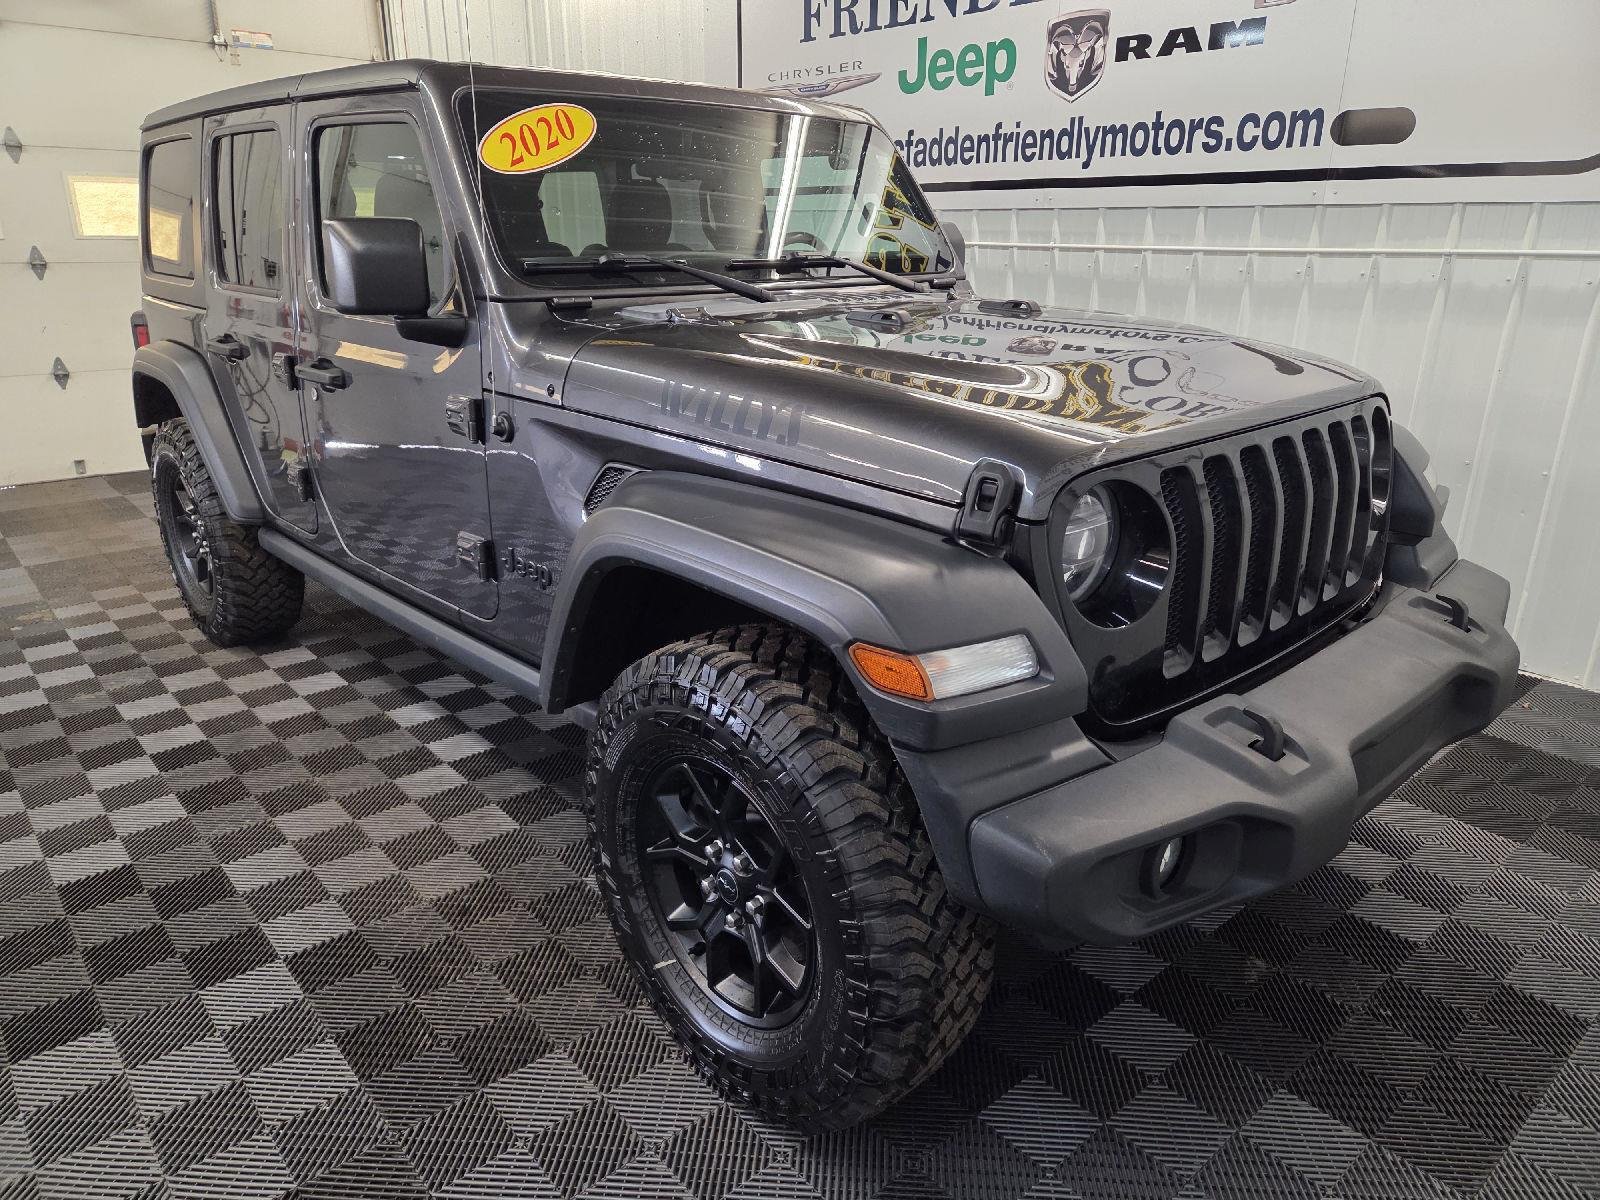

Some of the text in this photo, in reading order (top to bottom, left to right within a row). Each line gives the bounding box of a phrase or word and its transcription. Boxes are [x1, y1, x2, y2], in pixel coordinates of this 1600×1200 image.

[799, 0, 1044, 43] FRIE
[1114, 15, 1268, 63] RAM
[767, 60, 863, 83] CHRYSLER
[897, 36, 1017, 97] Jeep
[499, 108, 575, 168] 2020
[501, 546, 553, 590] Jeep
